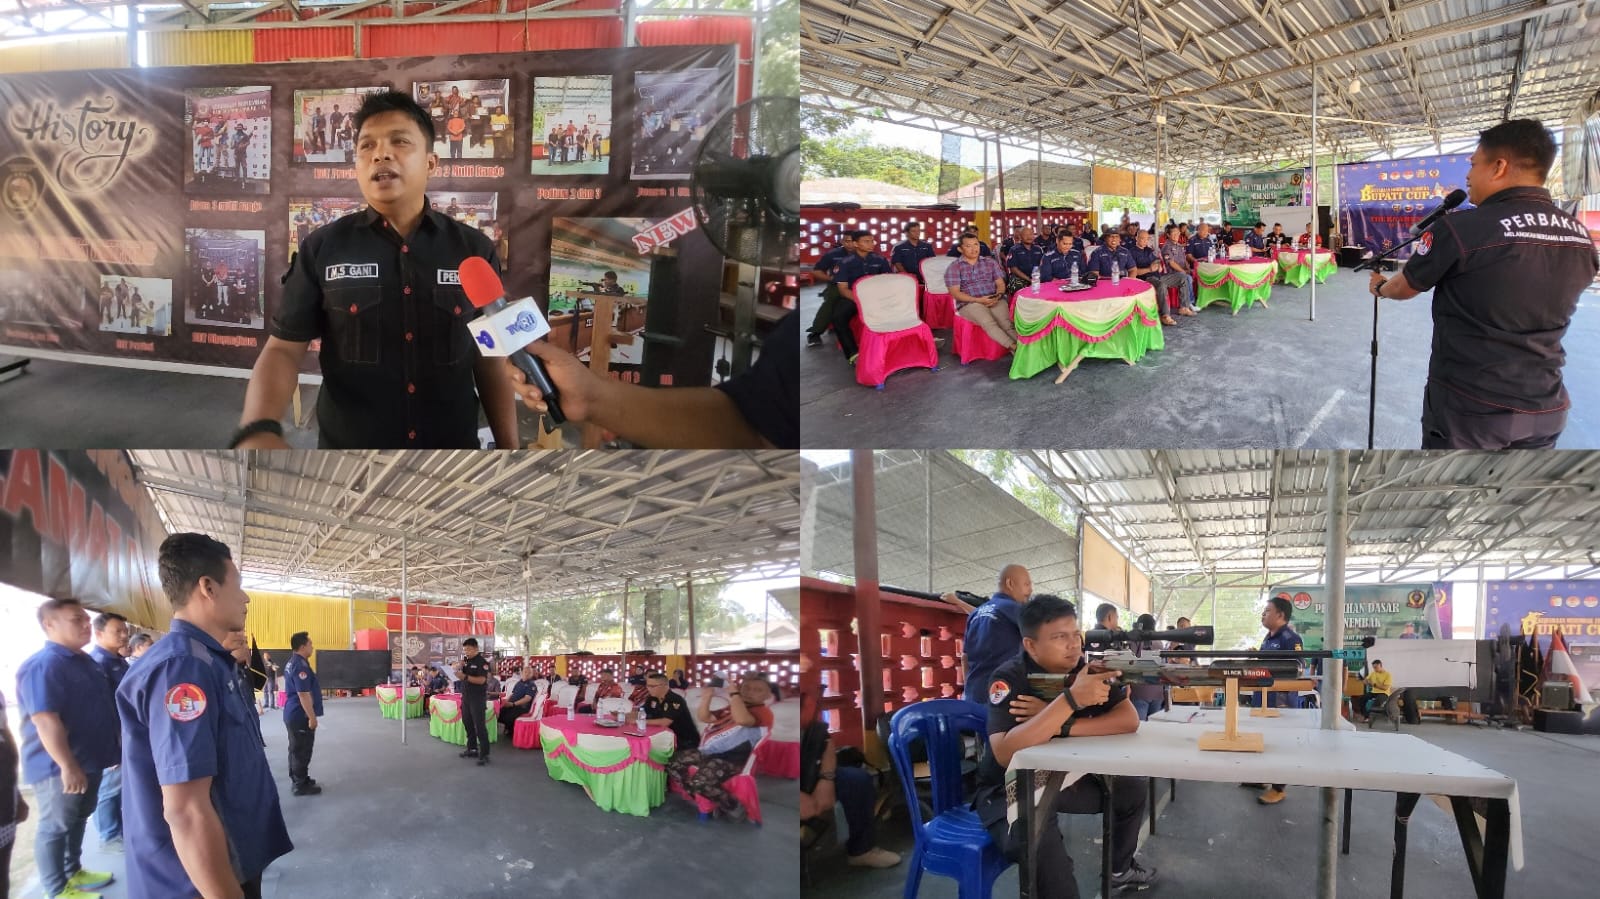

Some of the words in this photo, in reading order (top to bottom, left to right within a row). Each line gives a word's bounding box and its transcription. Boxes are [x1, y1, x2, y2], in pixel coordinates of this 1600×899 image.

[11, 96, 153, 193] History
[1360, 185, 1402, 201] BUPATI
[1406, 190, 1430, 200] CUP
[633, 206, 697, 254] NEW
[1500, 213, 1588, 238] PERBAKIN
[349, 266, 372, 276] GANI
[1367, 602, 1400, 613] DASAR
